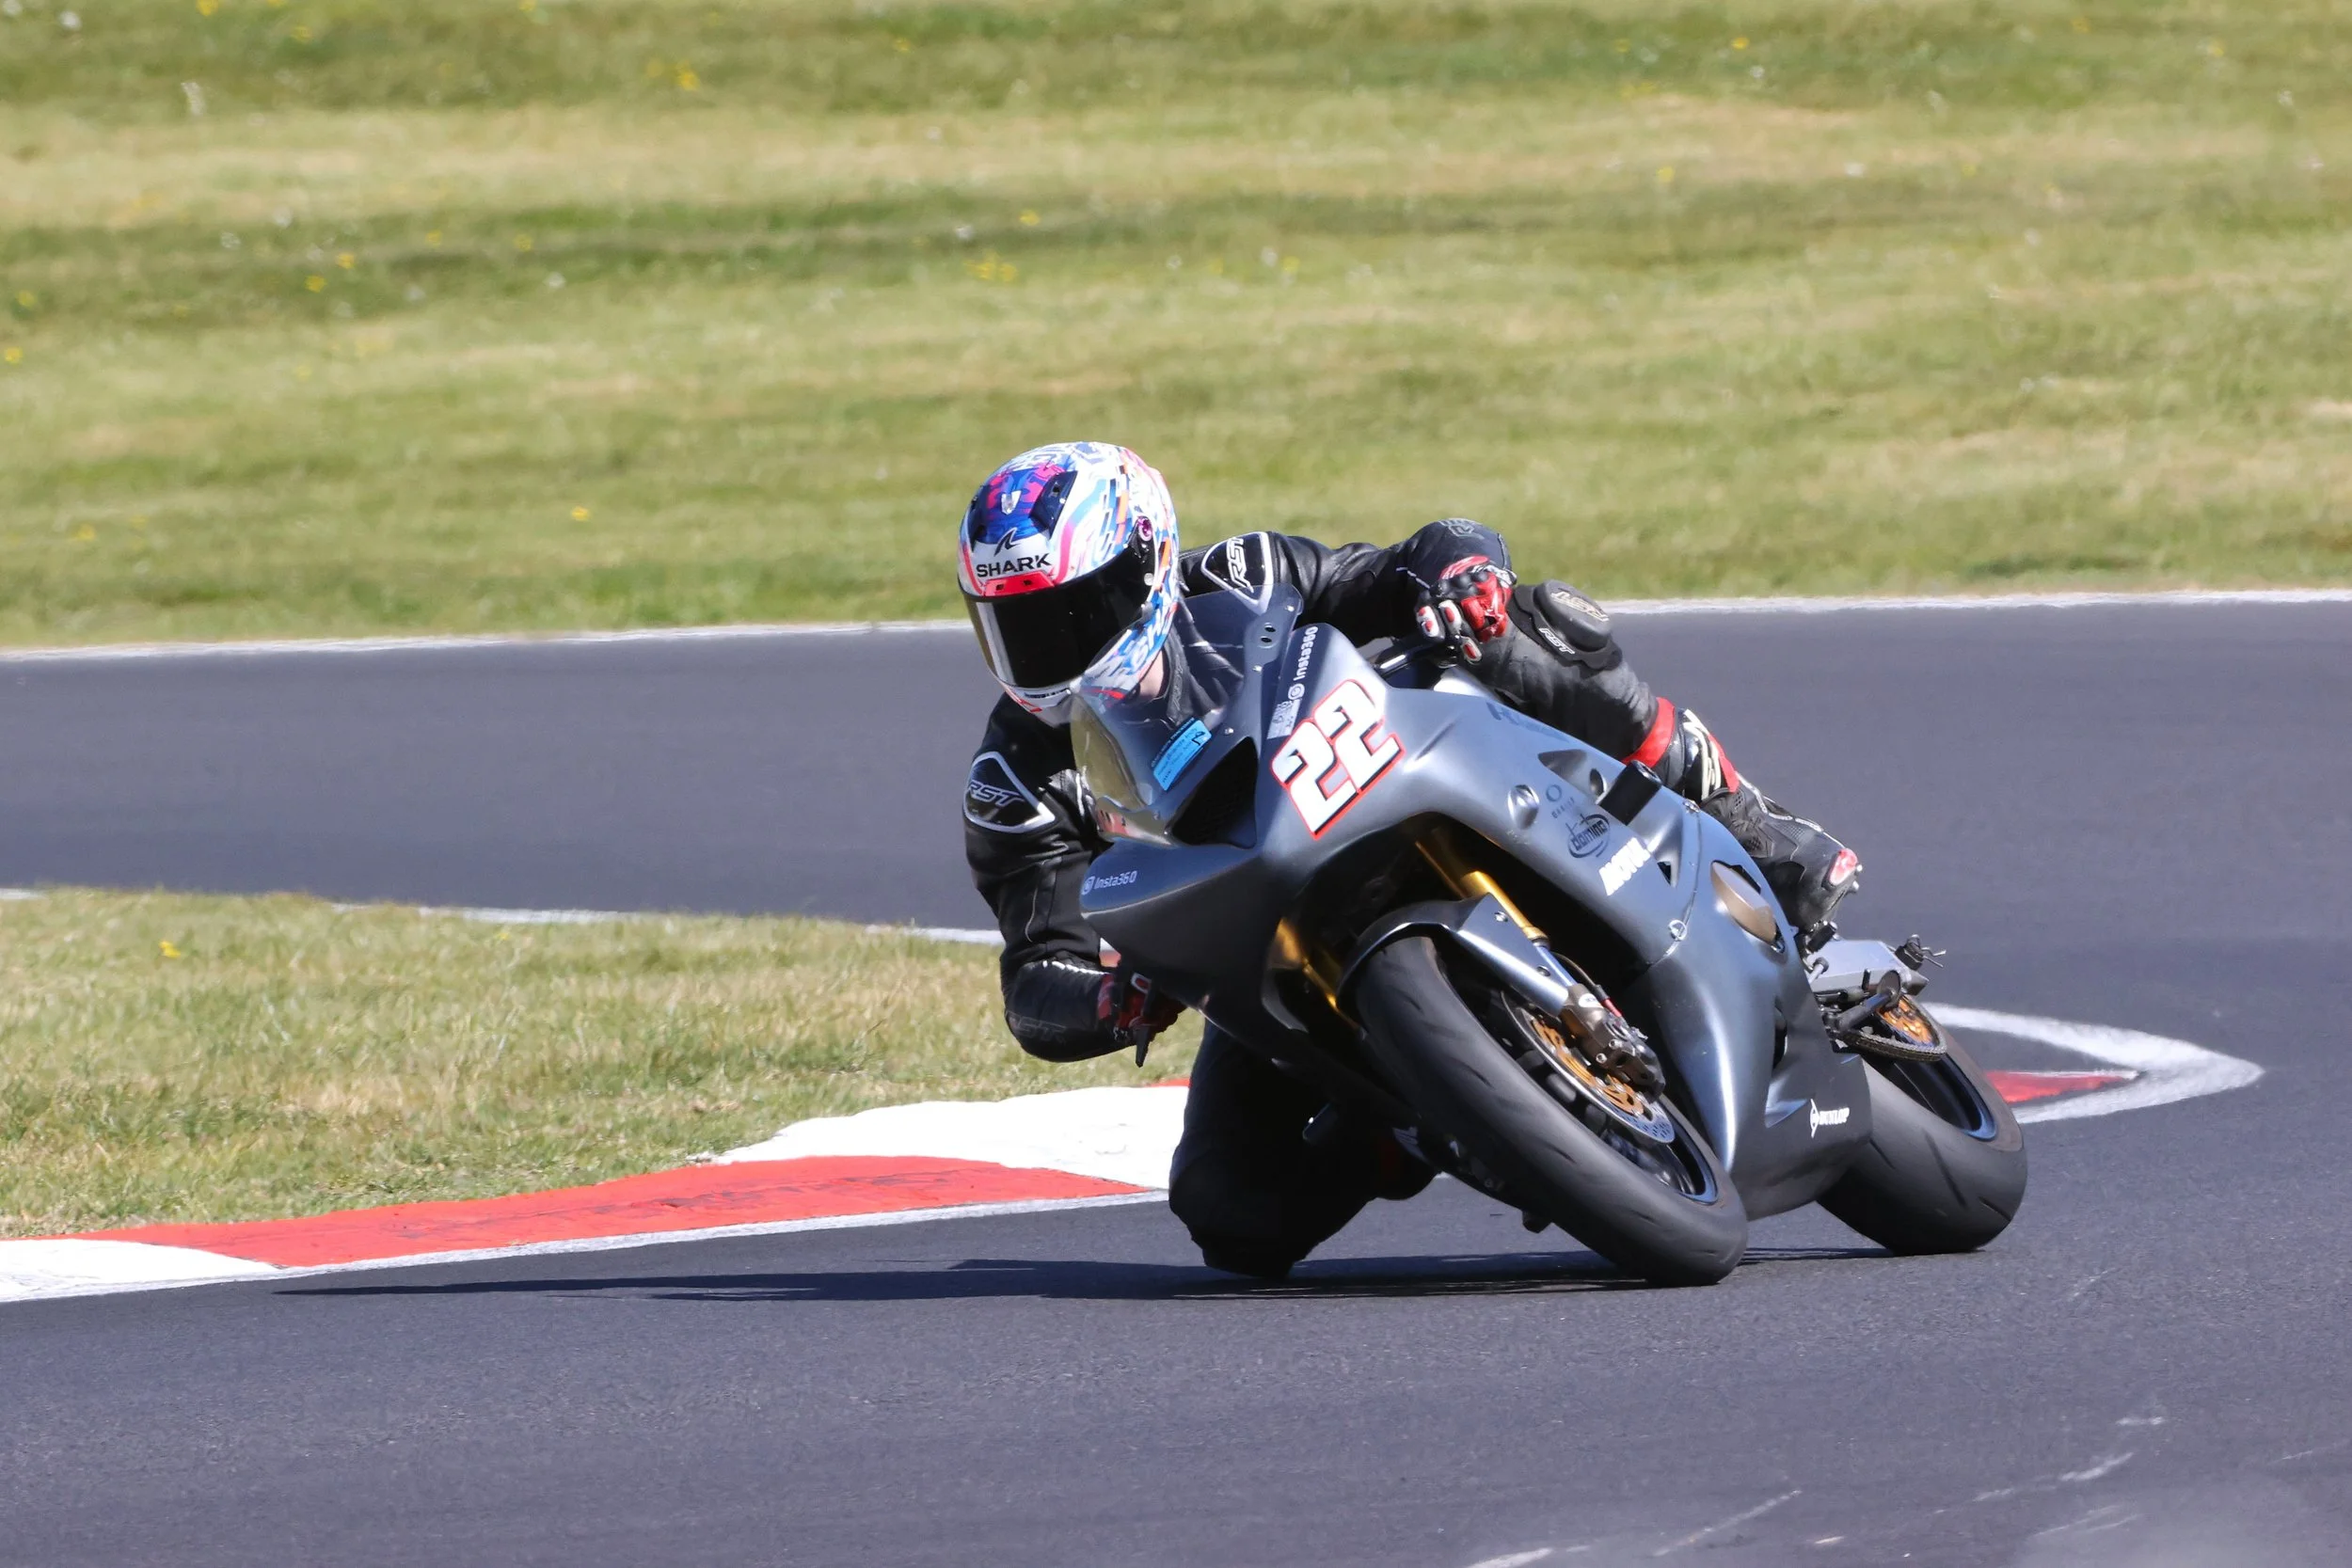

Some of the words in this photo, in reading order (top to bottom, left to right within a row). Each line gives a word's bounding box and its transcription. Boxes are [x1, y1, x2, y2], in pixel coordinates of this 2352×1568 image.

[977, 553, 1052, 578] SHARK
[1293, 626, 1319, 681] Insta360
[1539, 627, 1576, 655] RST
[1270, 678, 1407, 841] 22
[967, 779, 1025, 806] RST
[1093, 871, 1137, 890] Insta360
